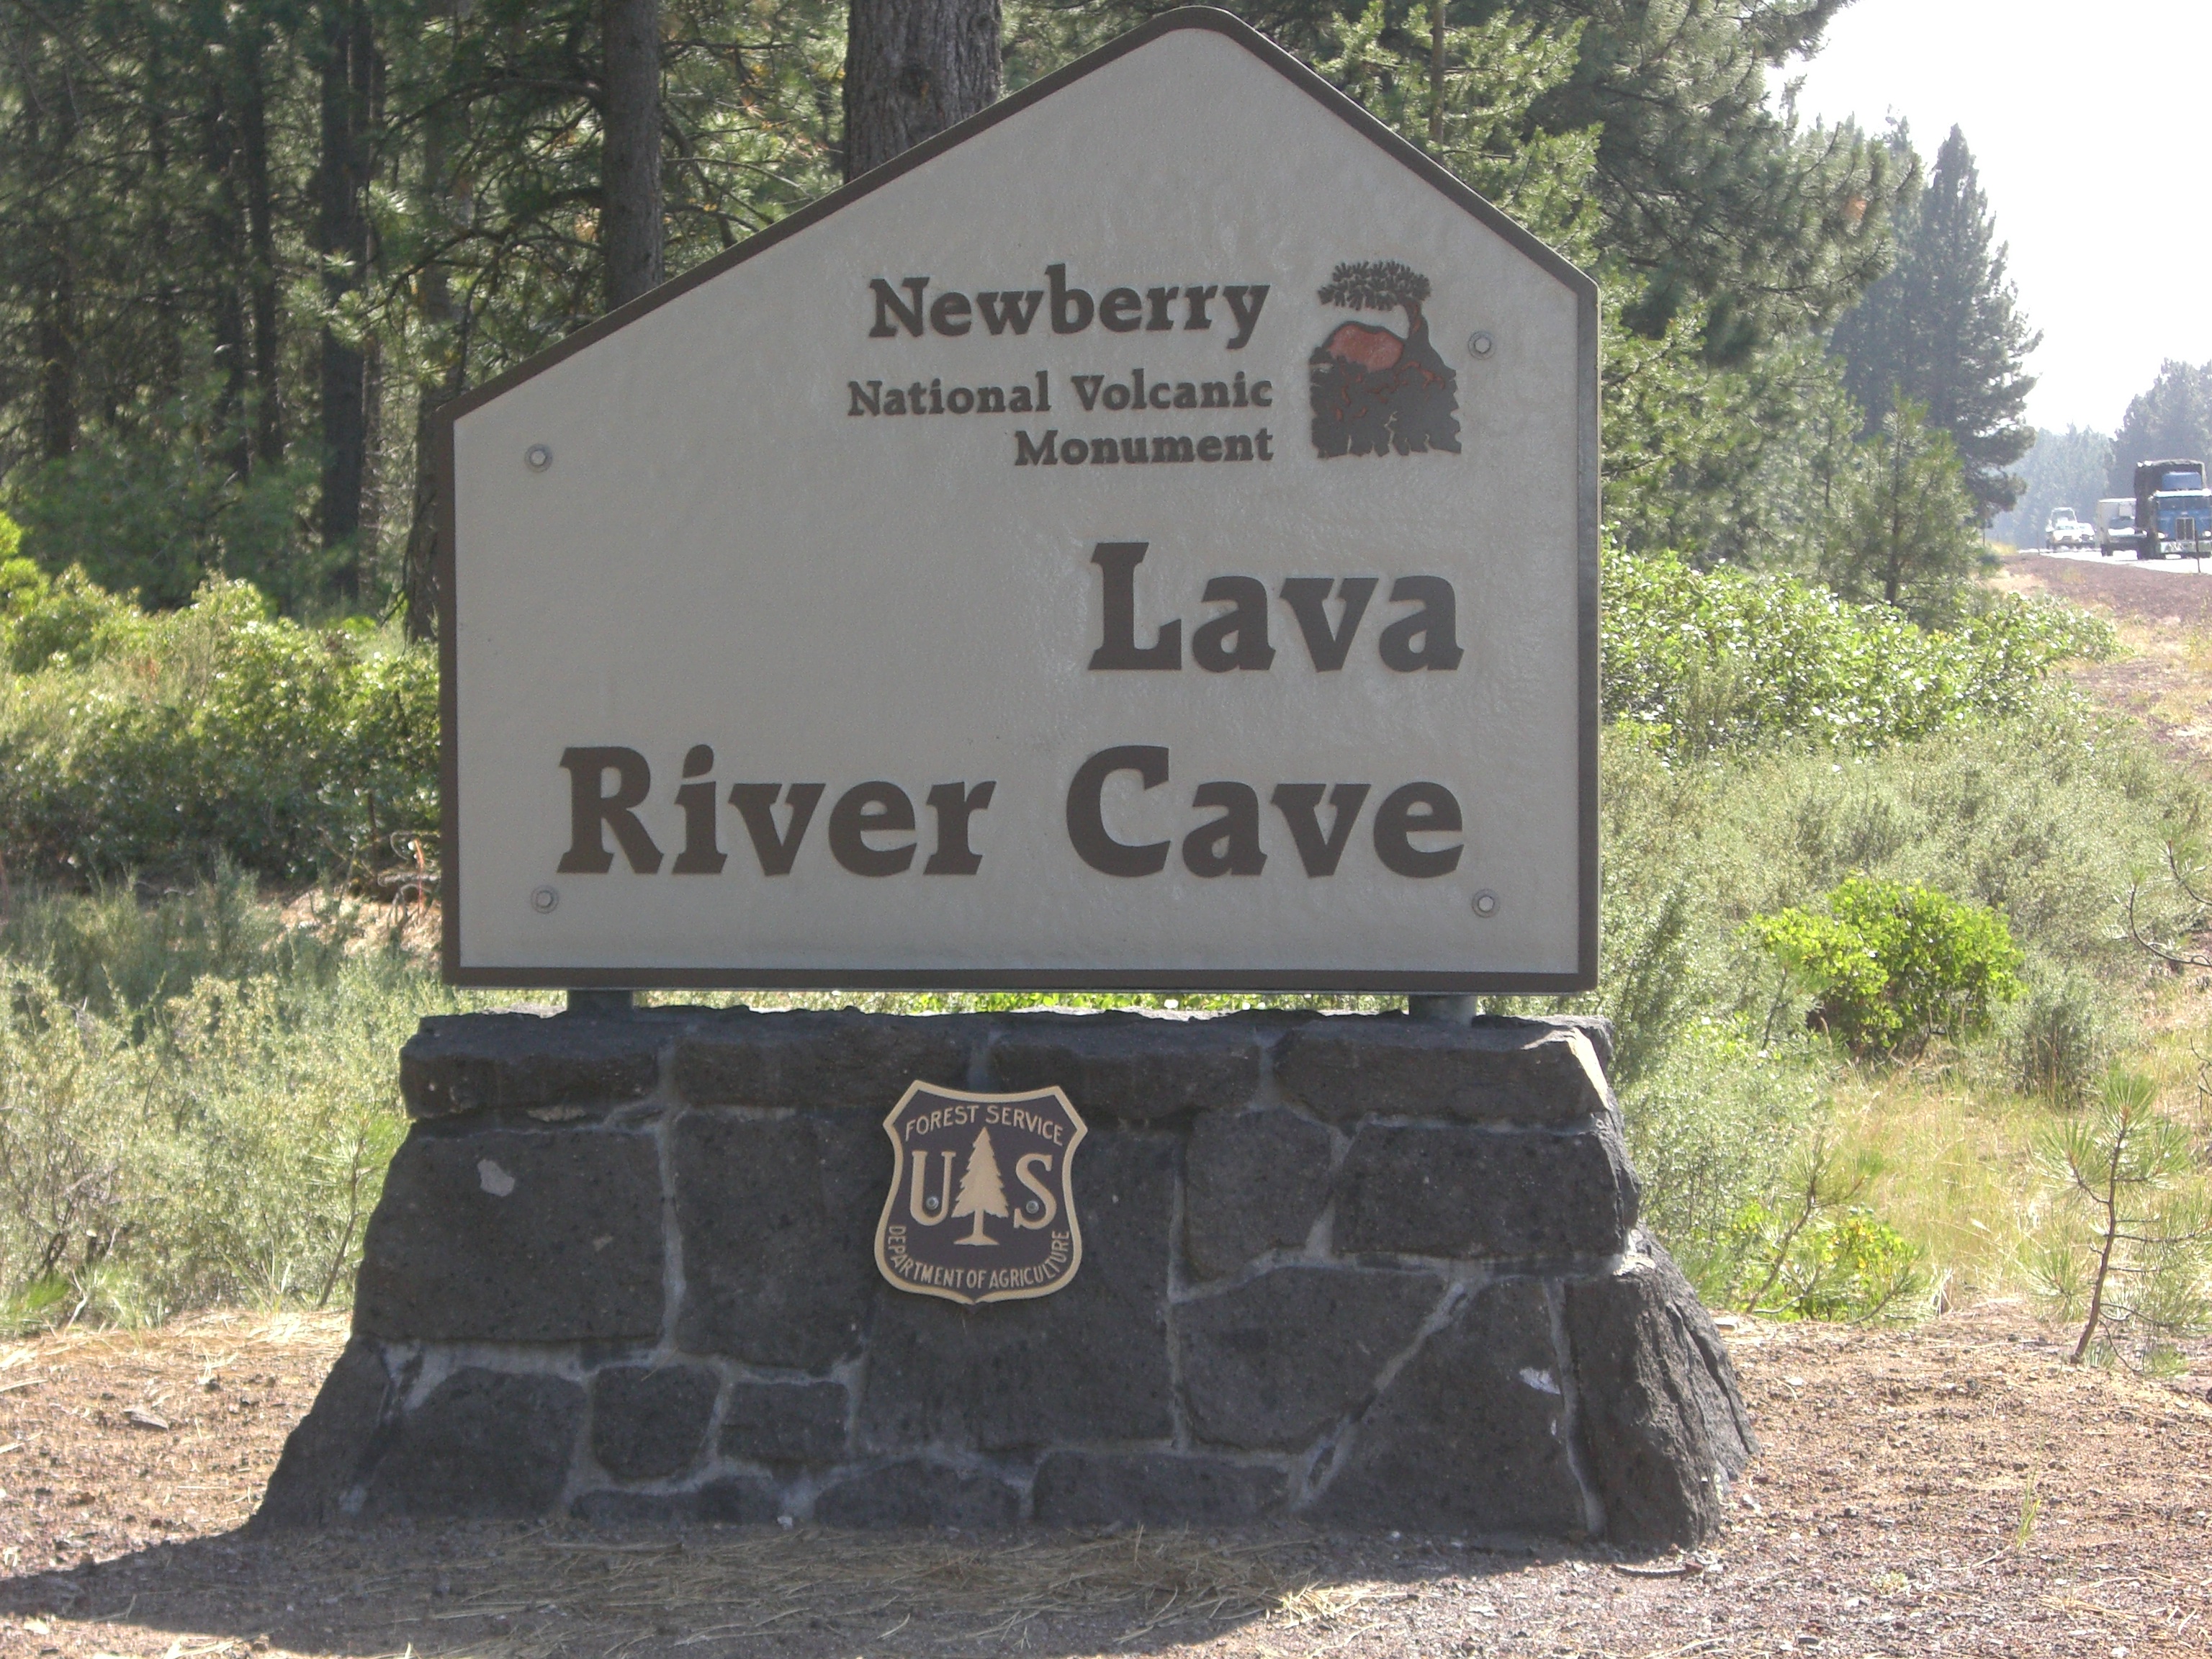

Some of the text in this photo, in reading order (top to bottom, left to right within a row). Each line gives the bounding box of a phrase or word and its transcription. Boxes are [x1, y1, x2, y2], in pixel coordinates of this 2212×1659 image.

[868, 263, 1271, 351] Newberry
[848, 368, 1273, 418] National Volcanic
[1014, 428, 1274, 467] Monument
[1087, 541, 1465, 673] Lava
[556, 745, 1465, 879] River Cave
[904, 1105, 1064, 1146] FOREST SERVICE
[889, 1225, 1069, 1290] DEPARTMENT OF AGRICULTURE
